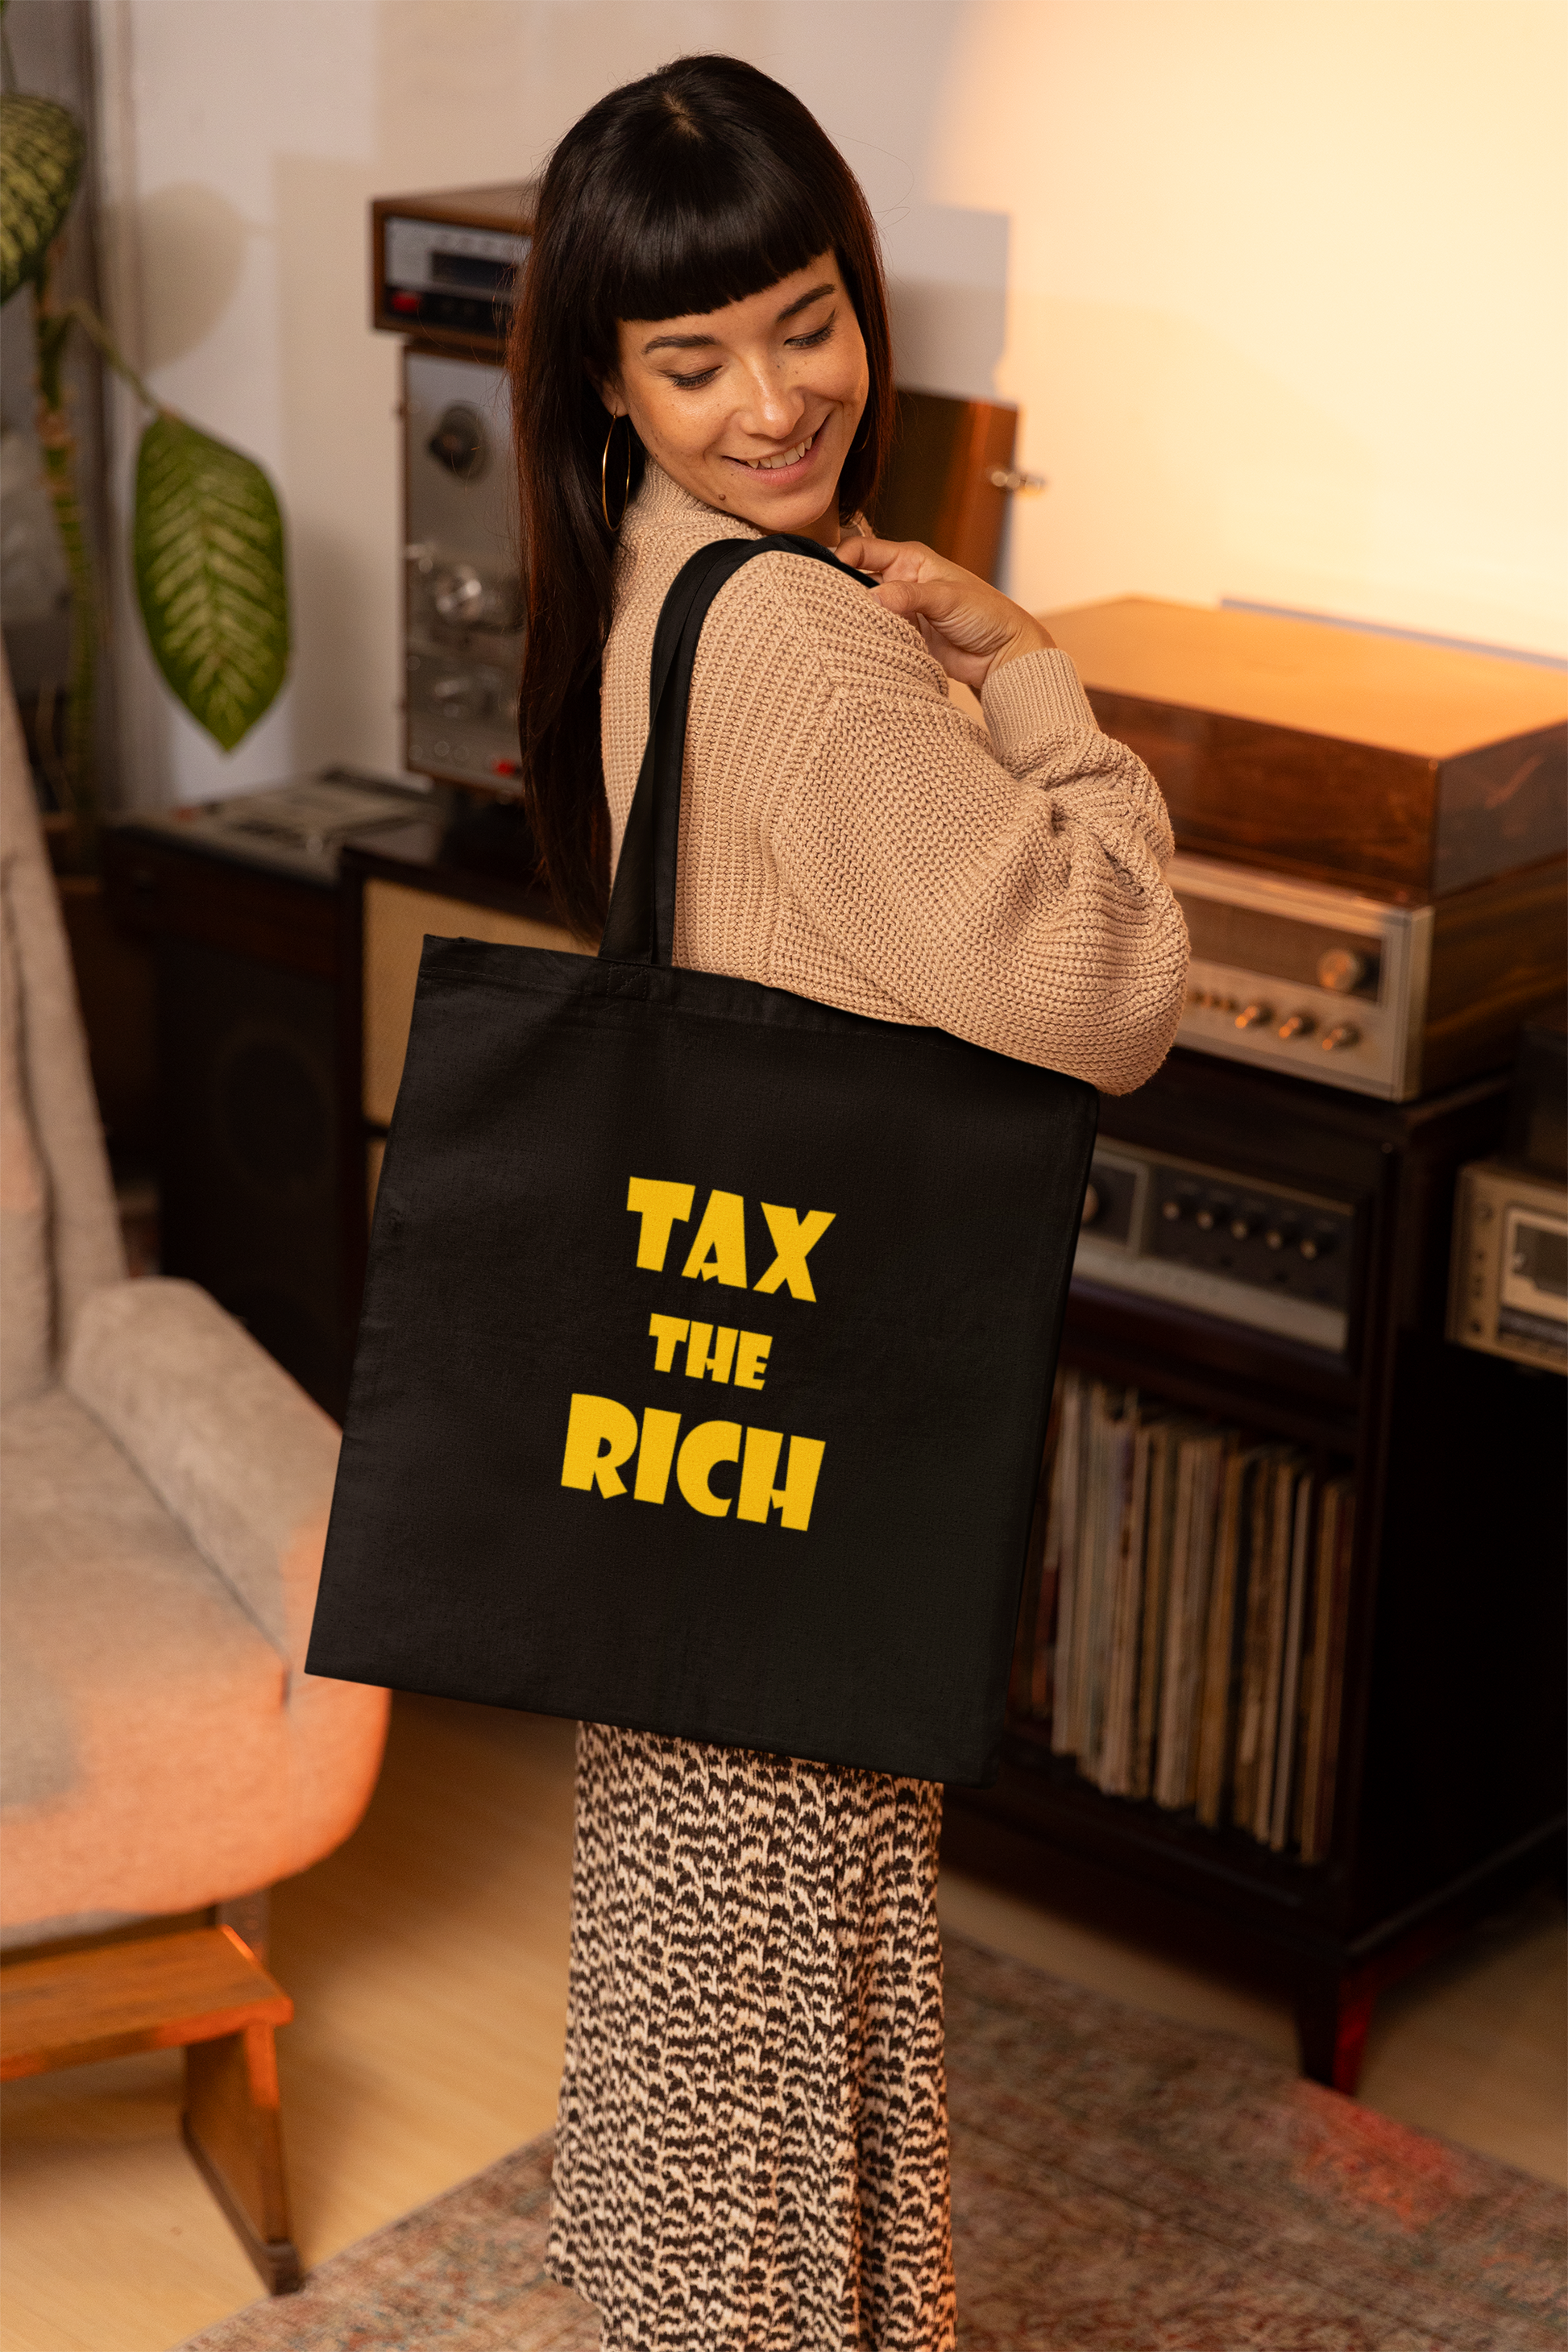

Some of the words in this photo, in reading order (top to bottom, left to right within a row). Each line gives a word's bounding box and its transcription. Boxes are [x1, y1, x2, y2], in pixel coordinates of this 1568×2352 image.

[627, 1177, 836, 1301] TAX
[649, 1313, 772, 1391] THE
[561, 1393, 826, 1532] RICH
